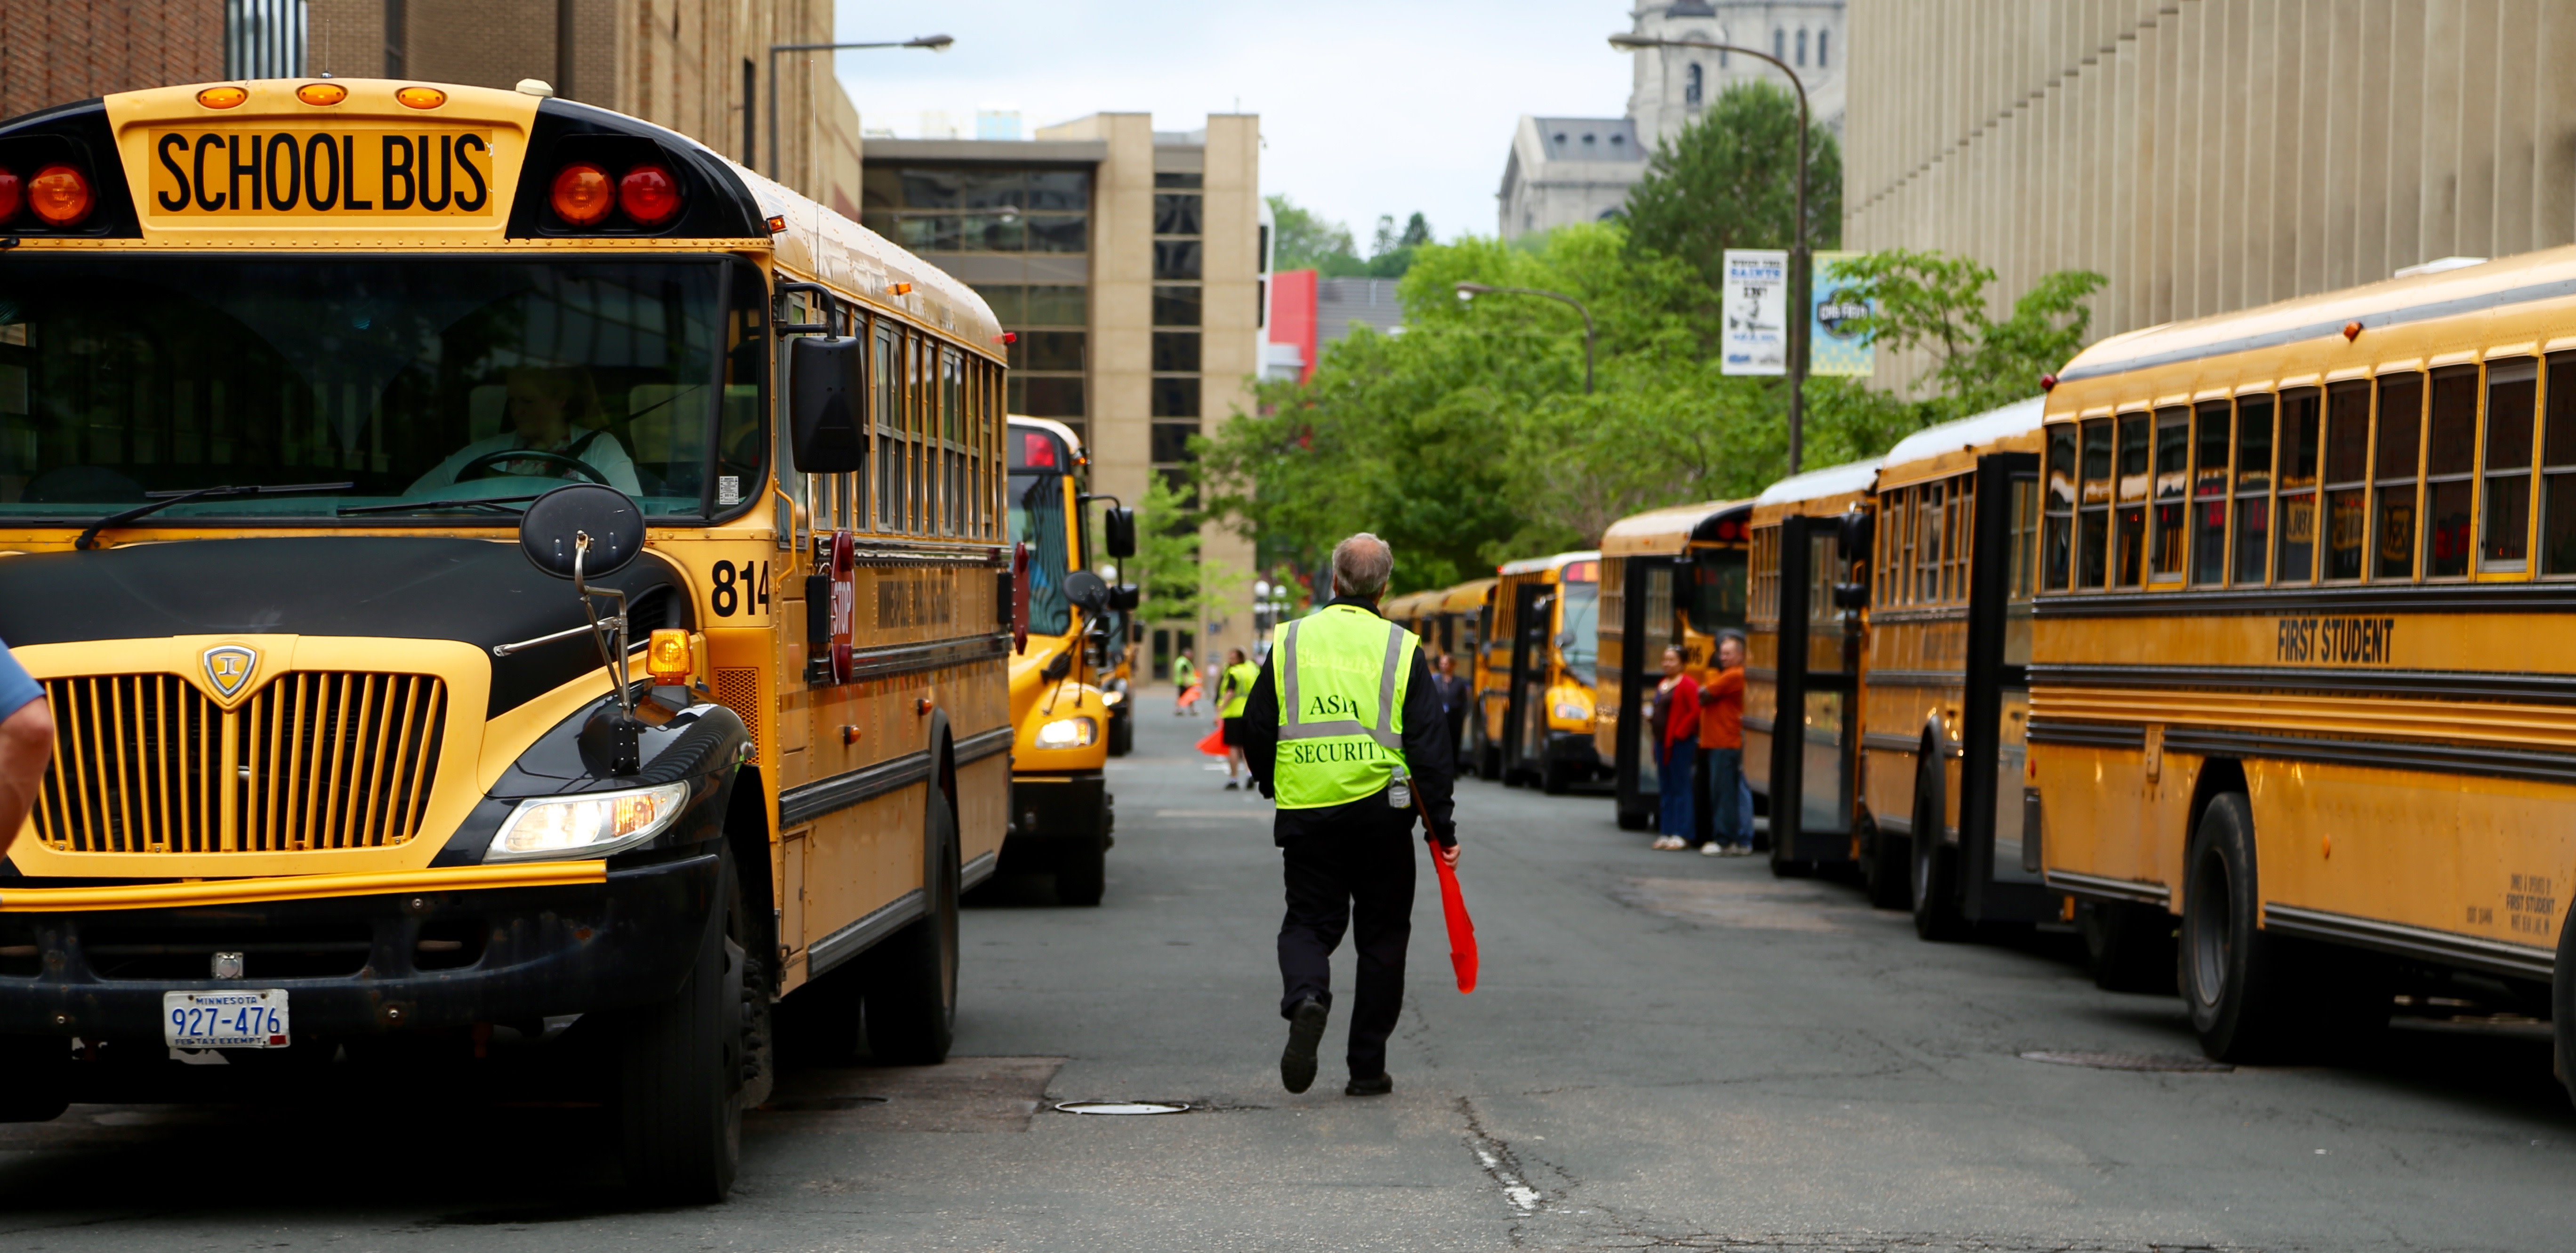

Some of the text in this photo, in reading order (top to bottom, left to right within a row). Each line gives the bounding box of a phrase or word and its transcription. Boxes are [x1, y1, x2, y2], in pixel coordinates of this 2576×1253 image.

[158, 133, 487, 212] SCHOOL BUS
[712, 560, 769, 617] 814
[833, 581, 851, 634] STOP
[2278, 619, 2394, 663] FIRST STUDENT
[1310, 695, 1360, 719] ASIA
[1295, 742, 1386, 764] SECURITY
[2507, 893, 2555, 915] FIRST STUDENT
[196, 996, 257, 1005] MINNESOTA
[172, 1006, 280, 1035] 927-476
